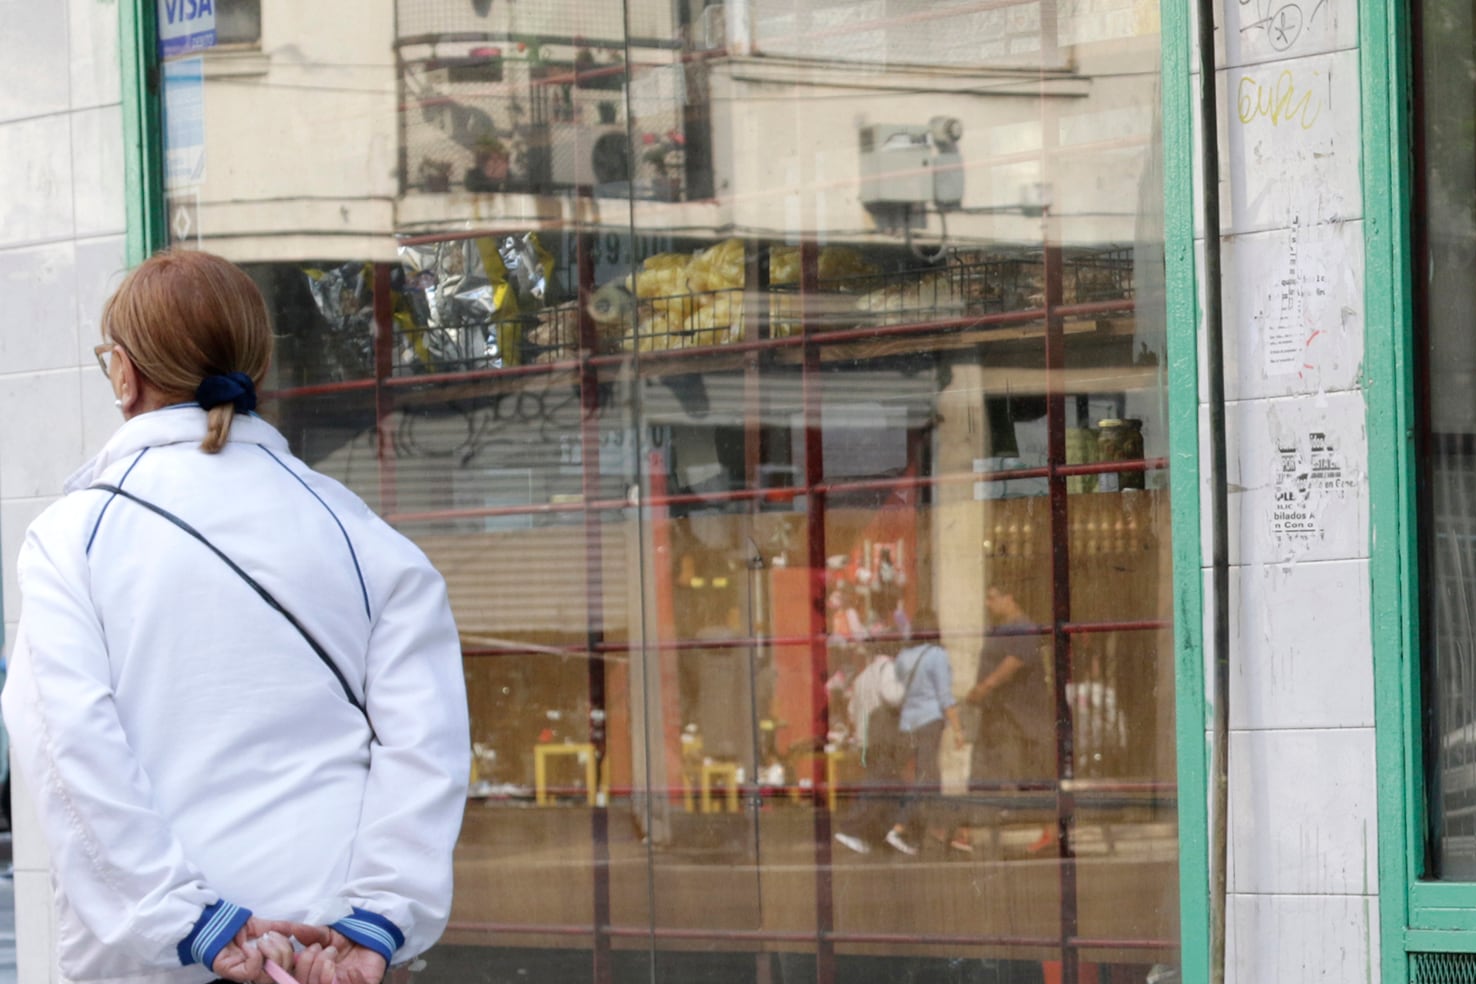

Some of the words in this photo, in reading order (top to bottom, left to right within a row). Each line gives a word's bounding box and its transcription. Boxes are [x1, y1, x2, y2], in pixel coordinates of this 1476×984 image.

[165, 0, 212, 24] VISA
[1274, 511, 1306, 520] bilados
[1284, 521, 1304, 529] Con
